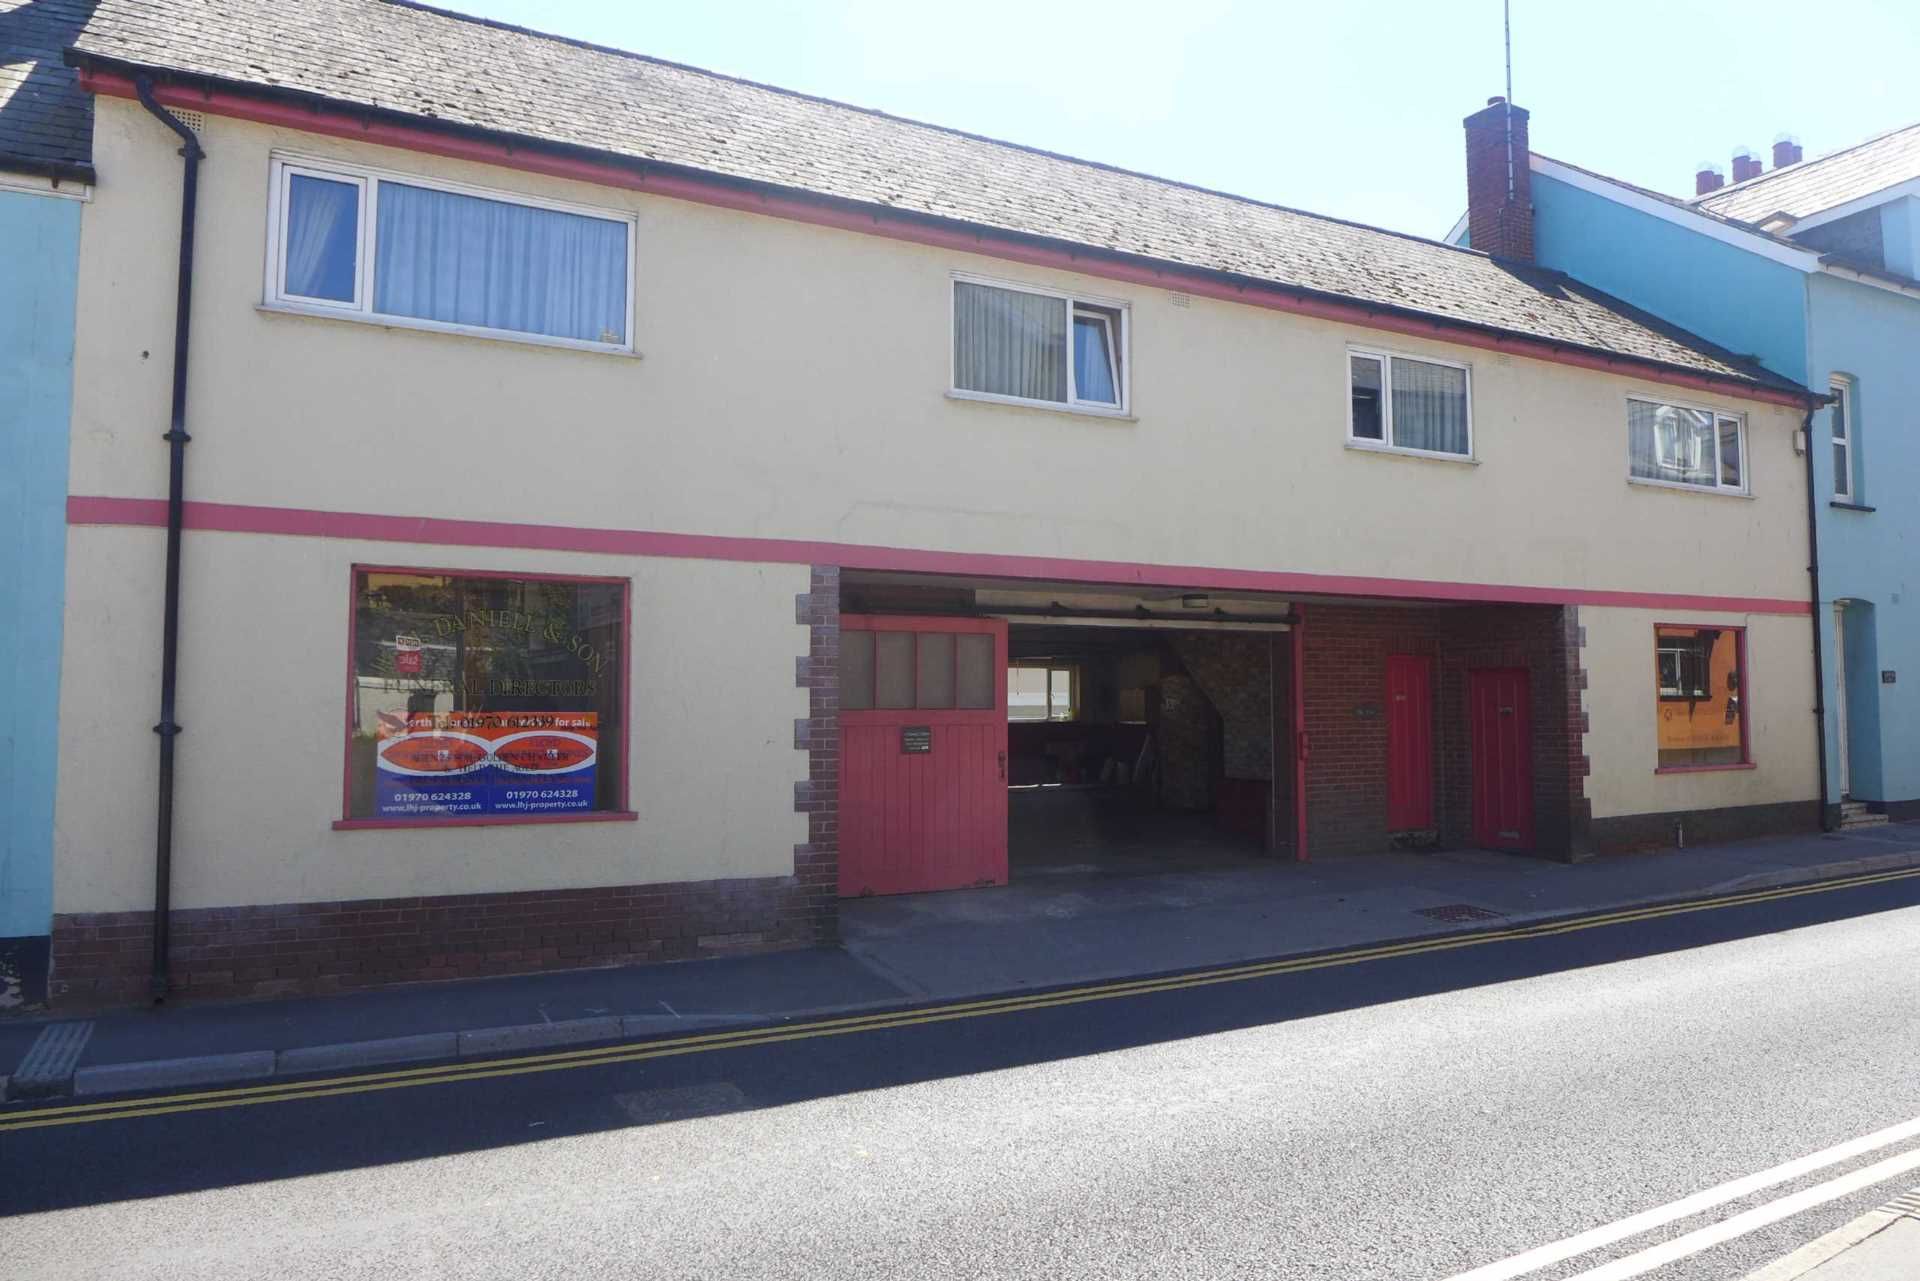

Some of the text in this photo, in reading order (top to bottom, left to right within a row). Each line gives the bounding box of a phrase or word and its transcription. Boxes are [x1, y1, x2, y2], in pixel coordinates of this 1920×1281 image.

[544, 624, 561, 643] &
[384, 679, 596, 697] FUNERAL DIRECTORS
[554, 717, 570, 727] for
[394, 792, 472, 801] 01970 624328
[506, 790, 578, 799] 01970 624328
[495, 800, 588, 810] www.lhj-property.co.uk
